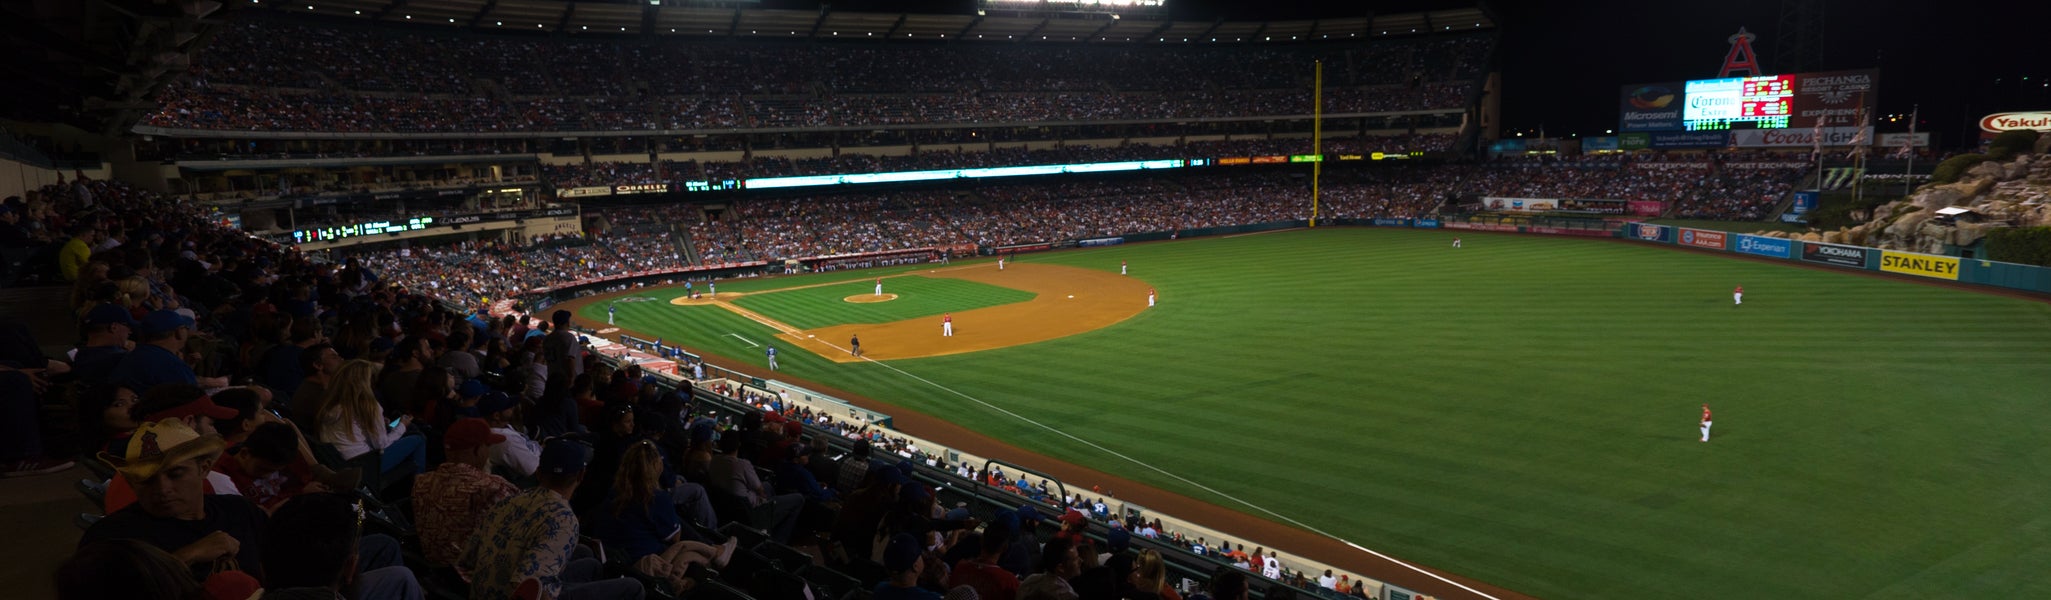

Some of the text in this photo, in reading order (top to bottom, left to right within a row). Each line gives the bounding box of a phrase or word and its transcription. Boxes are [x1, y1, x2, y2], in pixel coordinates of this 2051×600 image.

[1717, 26, 1760, 78] A
[1803, 74, 1871, 86] PECHANGA
[1691, 96, 1736, 108] Corona
[1624, 110, 1678, 120] Microsemi
[1762, 130, 1858, 145] Coors IGH
[631, 183, 667, 191] OAKLEY
[450, 215, 480, 224] LEXUS
[1695, 231, 1722, 240] Insurance
[1695, 239, 1721, 248] AAA.com
[1753, 242, 1786, 254] Experian
[1818, 246, 1862, 258] YOKOHAMA
[1882, 255, 1956, 274] STANLEY
